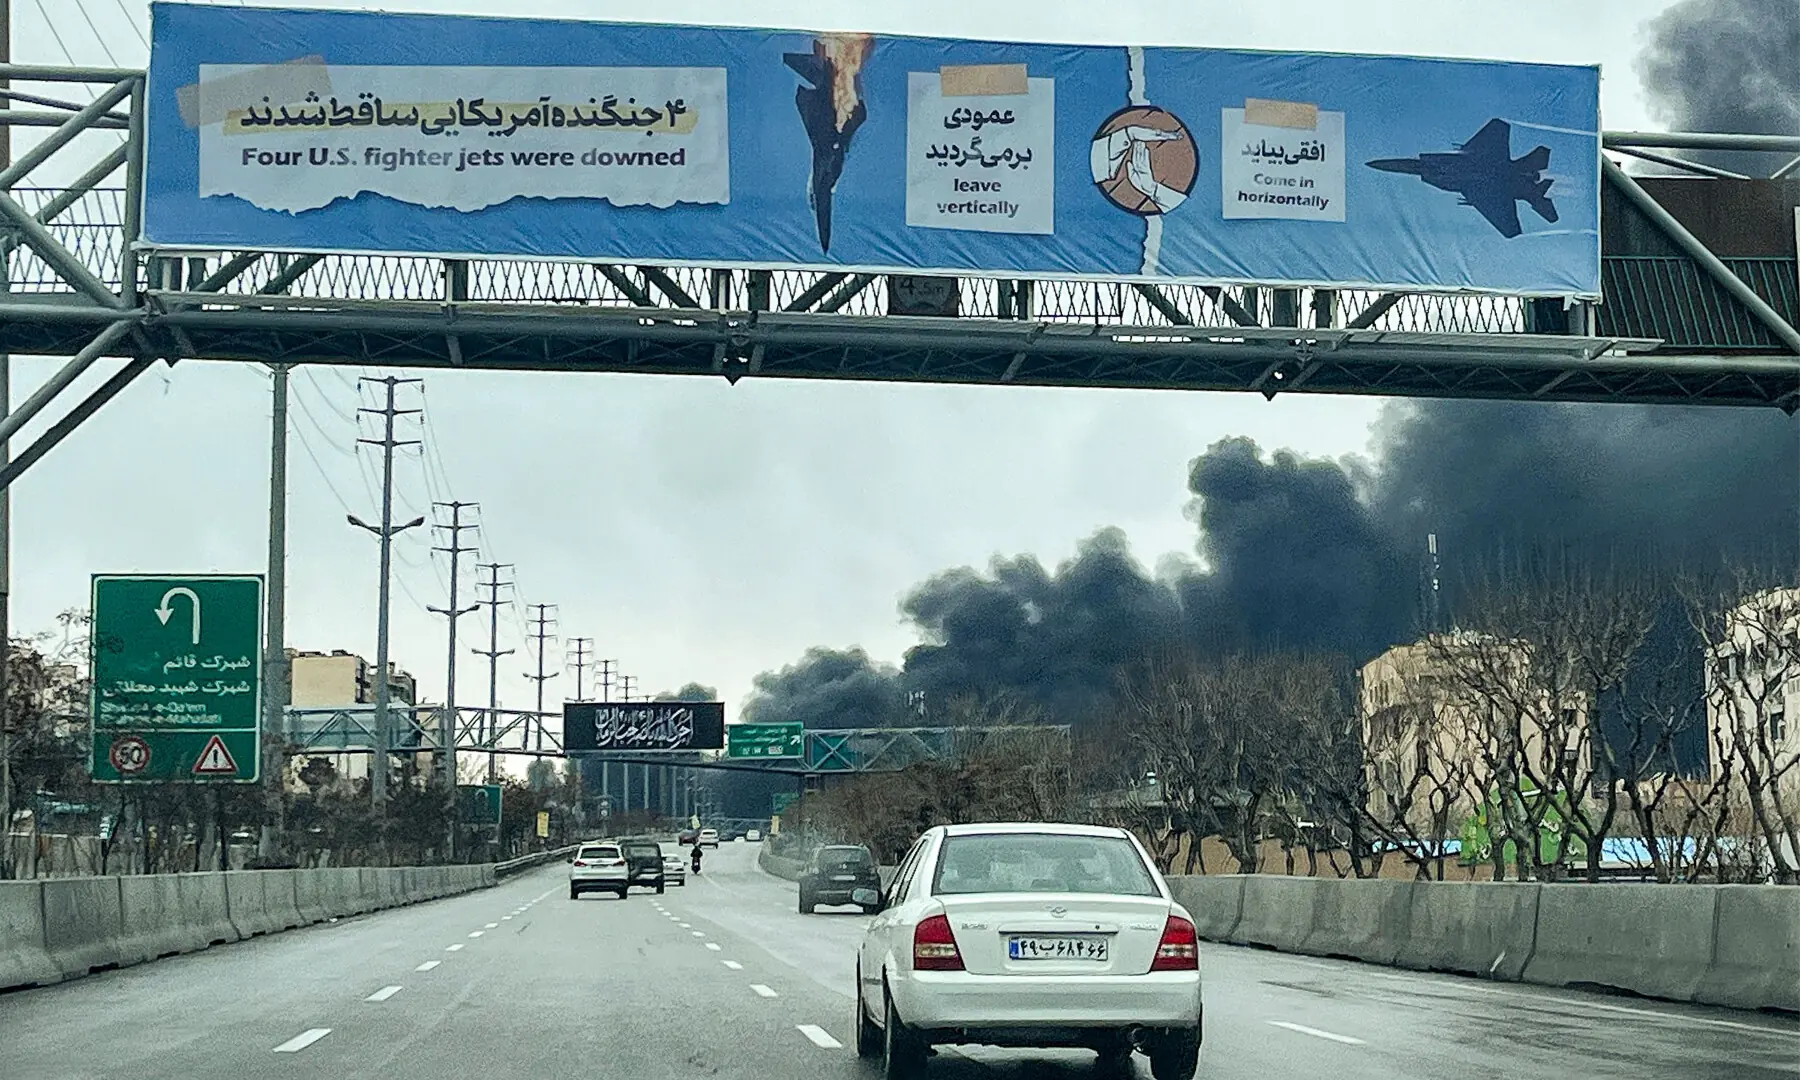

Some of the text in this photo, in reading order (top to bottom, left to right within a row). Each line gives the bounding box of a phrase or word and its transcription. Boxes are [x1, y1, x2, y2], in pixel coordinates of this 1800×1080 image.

[241, 91, 686, 136] ۴ جنگنده آمریکایی ساقط شدند
[944, 107, 1015, 131] عمودی
[242, 147, 685, 171] Four U.S. fighter jets were downed
[1284, 140, 1325, 165] افقی
[954, 178, 1002, 192] leave
[1254, 173, 1314, 188] Come in
[937, 200, 1019, 218] vertically
[1238, 190, 1329, 210] horizontally
[200, 655, 250, 671] شهرک
[158, 680, 198, 695] شهید
[201, 680, 250, 696] شهرک
[119, 746, 142, 765] 50
